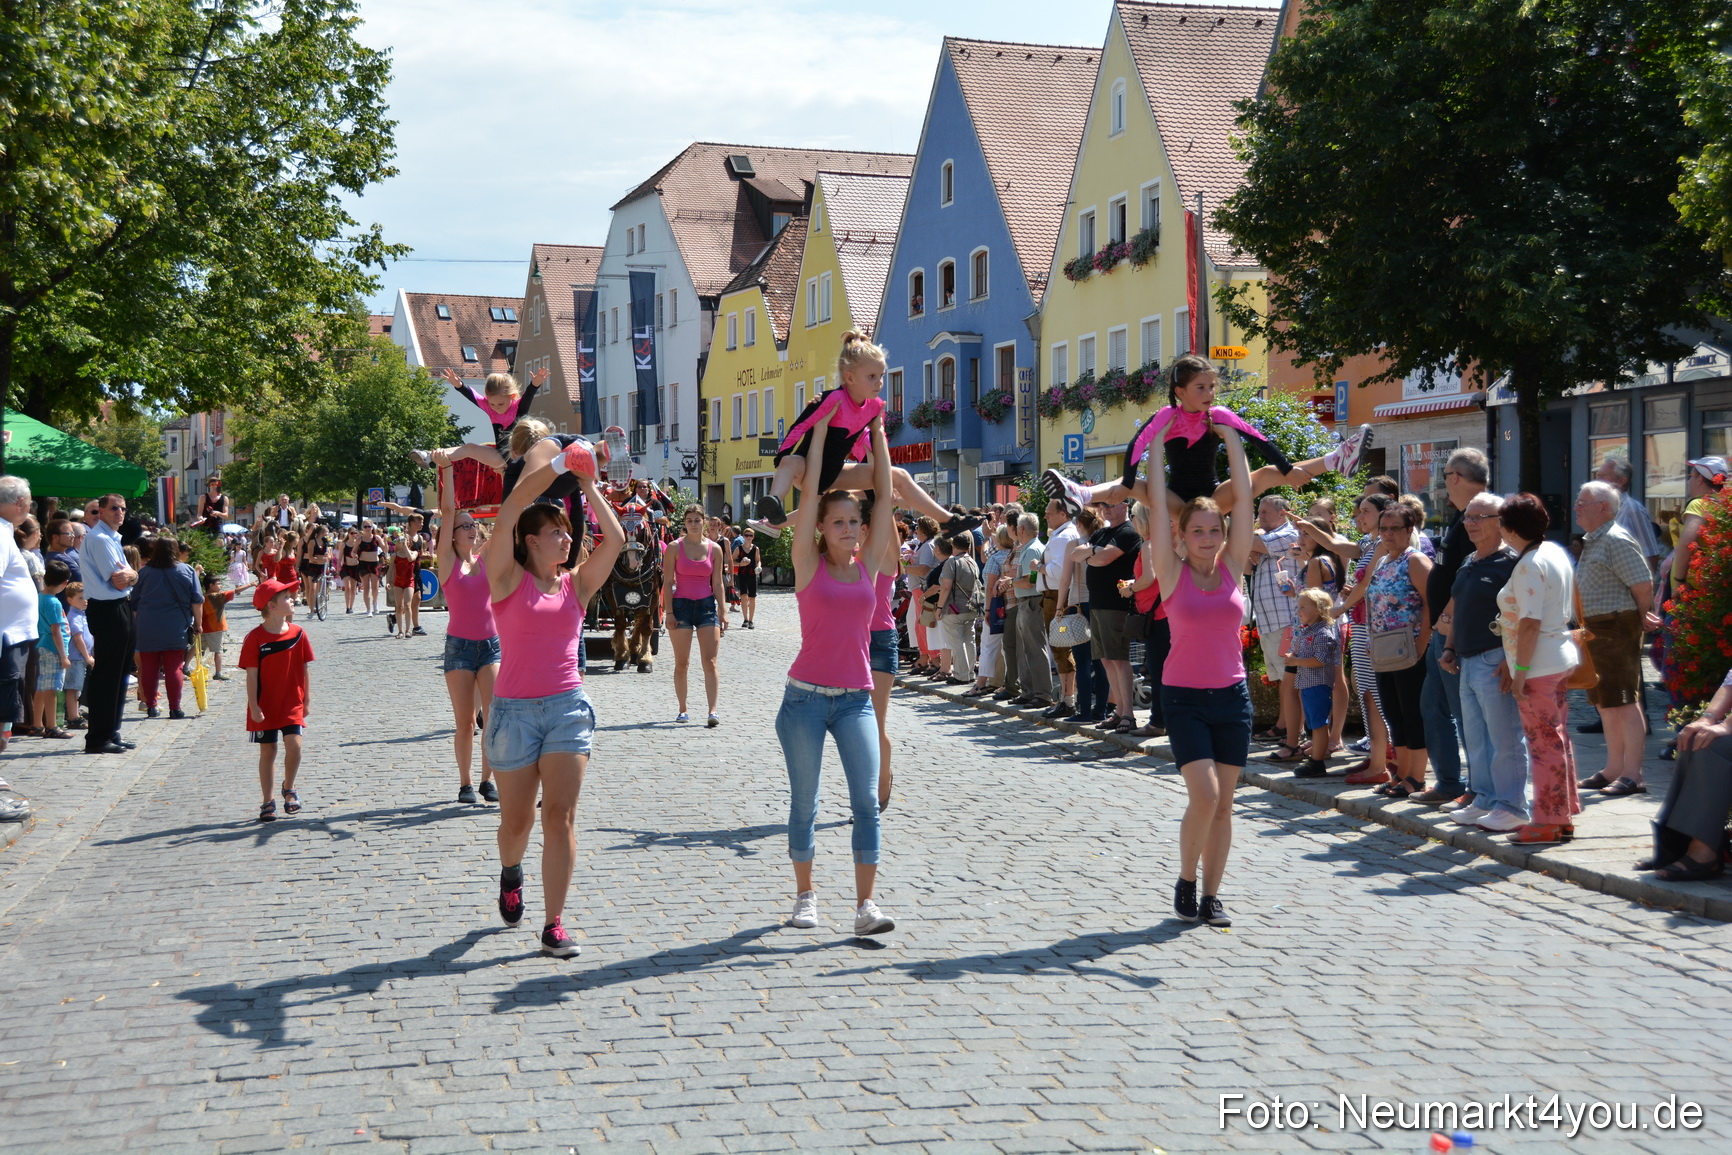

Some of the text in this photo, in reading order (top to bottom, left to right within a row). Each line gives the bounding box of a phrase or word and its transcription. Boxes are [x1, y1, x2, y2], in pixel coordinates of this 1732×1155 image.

[634, 325, 652, 370] K&L
[1215, 348, 1233, 357] KINO
[737, 367, 756, 388] HOTEL
[1338, 386, 1346, 416] P
[889, 441, 932, 465] POTHEKE
[1068, 437, 1080, 460] P
[735, 457, 763, 471] Restaurant
